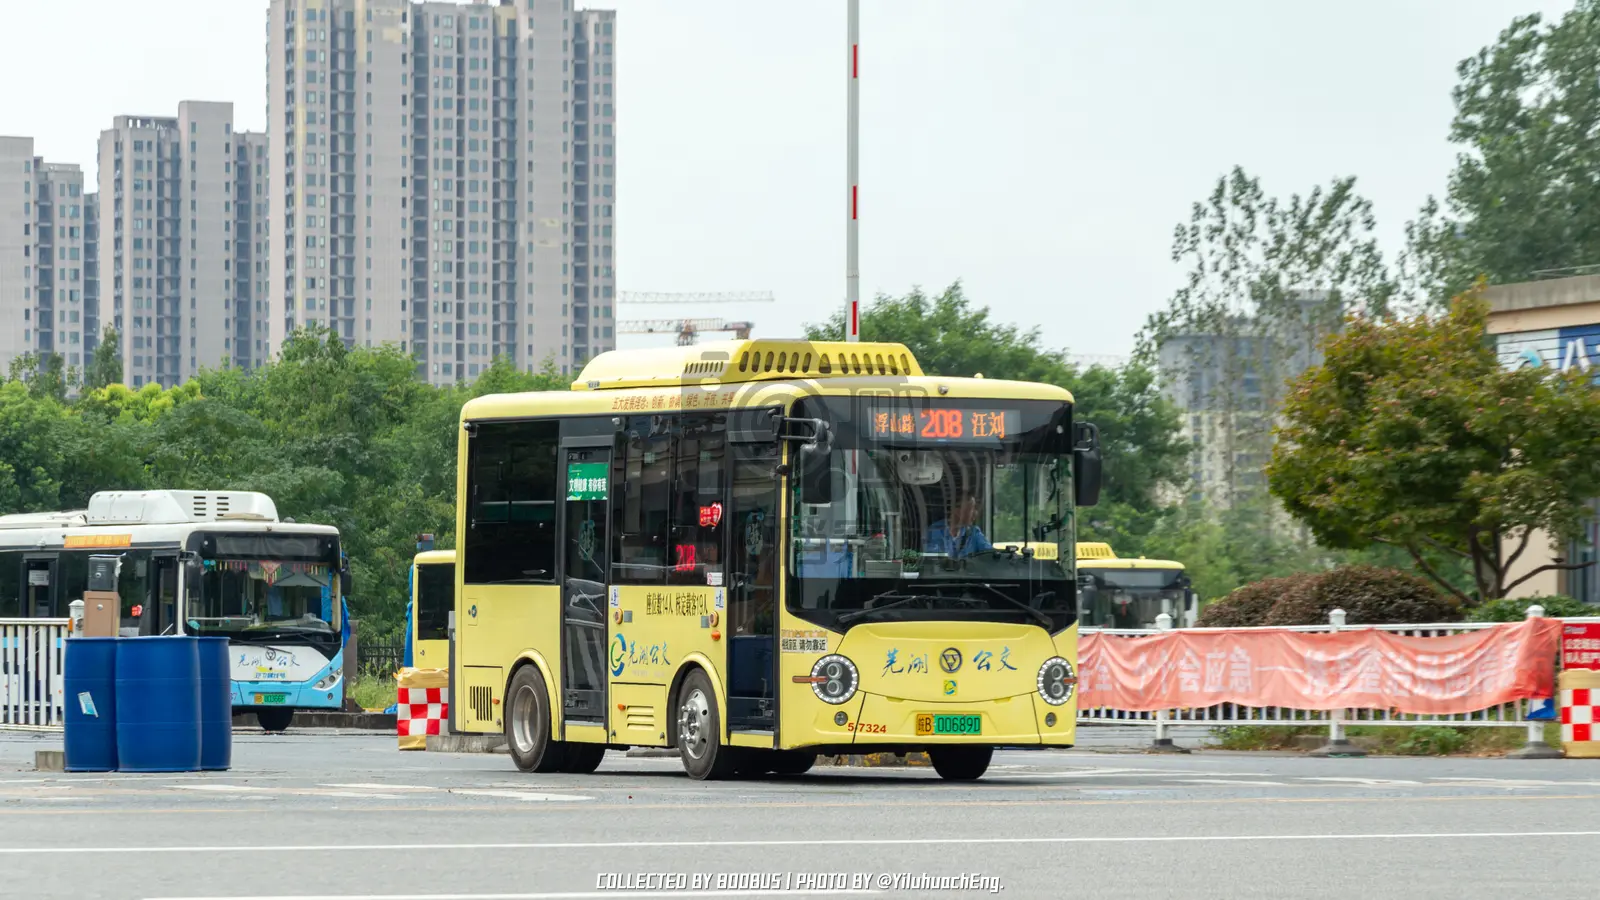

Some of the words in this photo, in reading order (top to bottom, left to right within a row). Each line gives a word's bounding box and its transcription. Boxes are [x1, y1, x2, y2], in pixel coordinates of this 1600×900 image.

[875, 411, 915, 433] 浮山路
[920, 409, 963, 438] 208
[971, 411, 1005, 439] 汪刘
[675, 544, 696, 571] 208
[973, 646, 1018, 673] 公交
